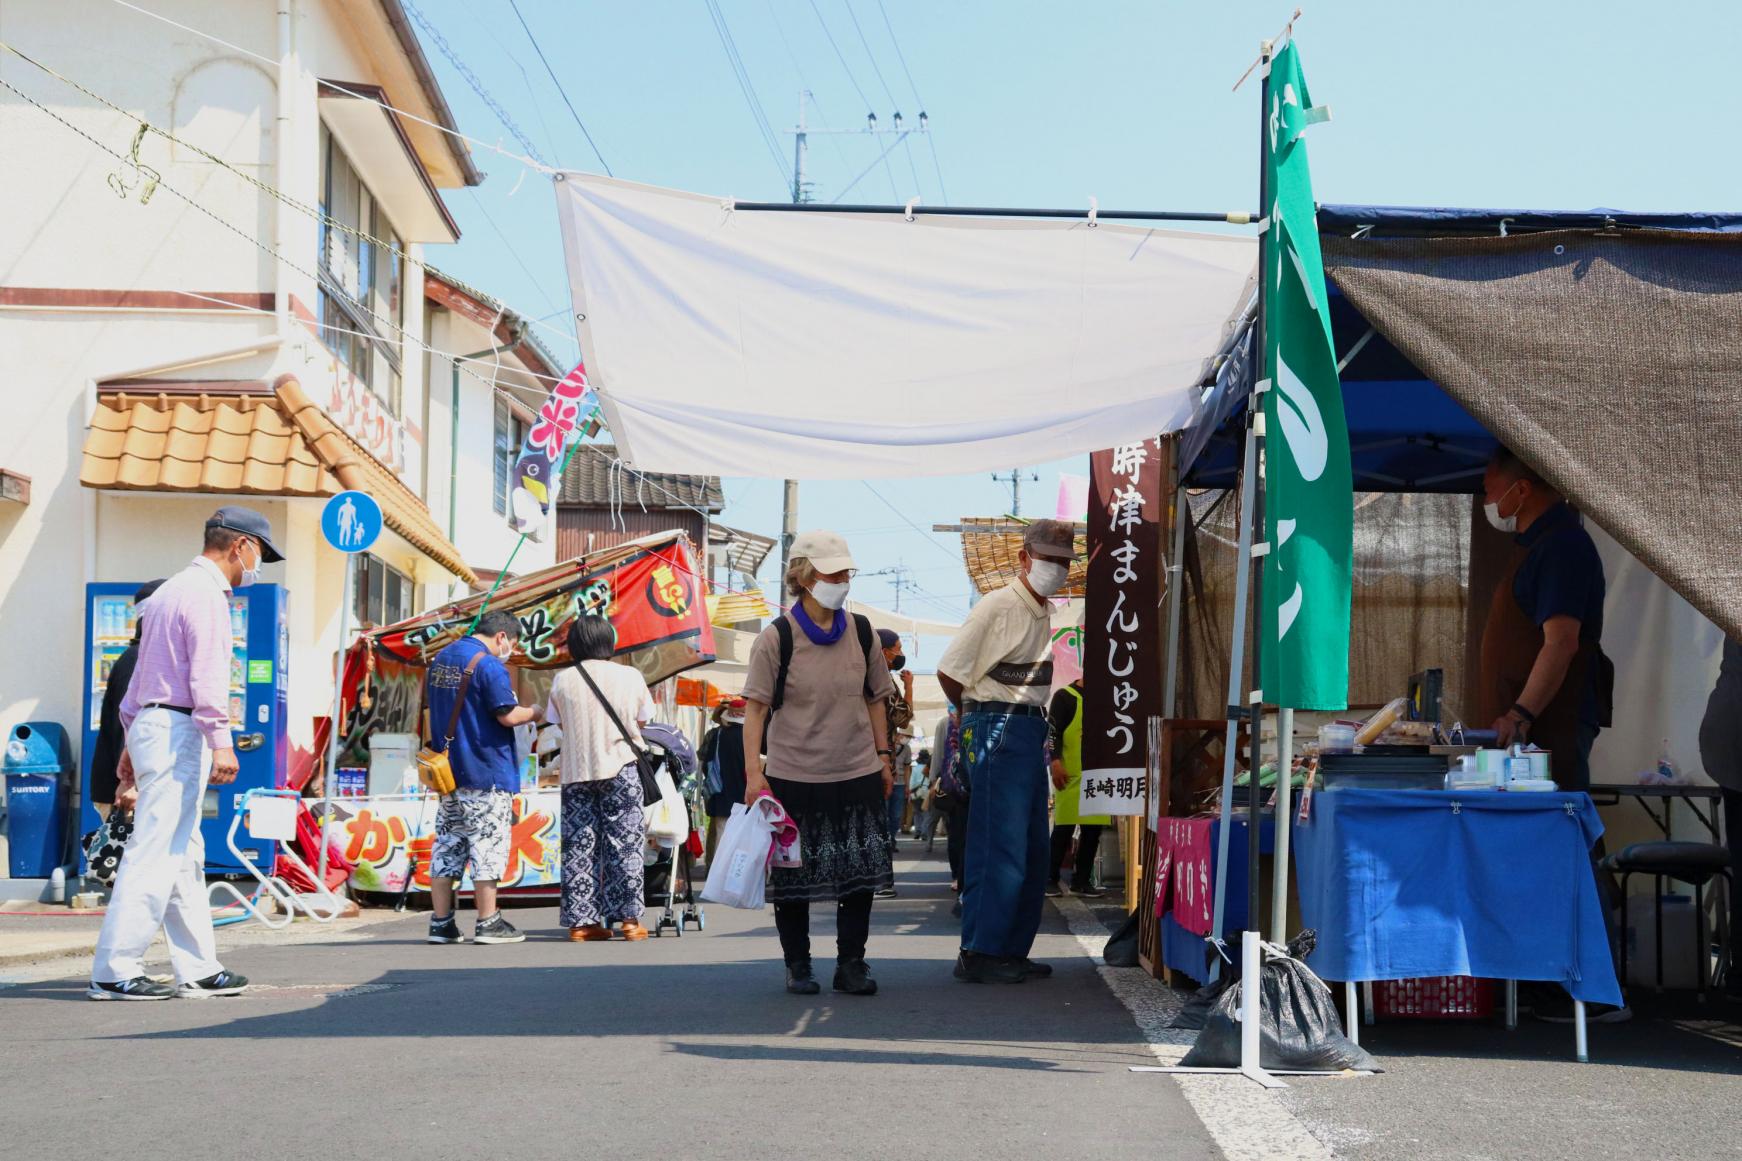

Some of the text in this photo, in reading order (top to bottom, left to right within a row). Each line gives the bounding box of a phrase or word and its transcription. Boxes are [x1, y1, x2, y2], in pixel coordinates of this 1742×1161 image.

[1106, 441, 1148, 755] 時津まんじゅう
